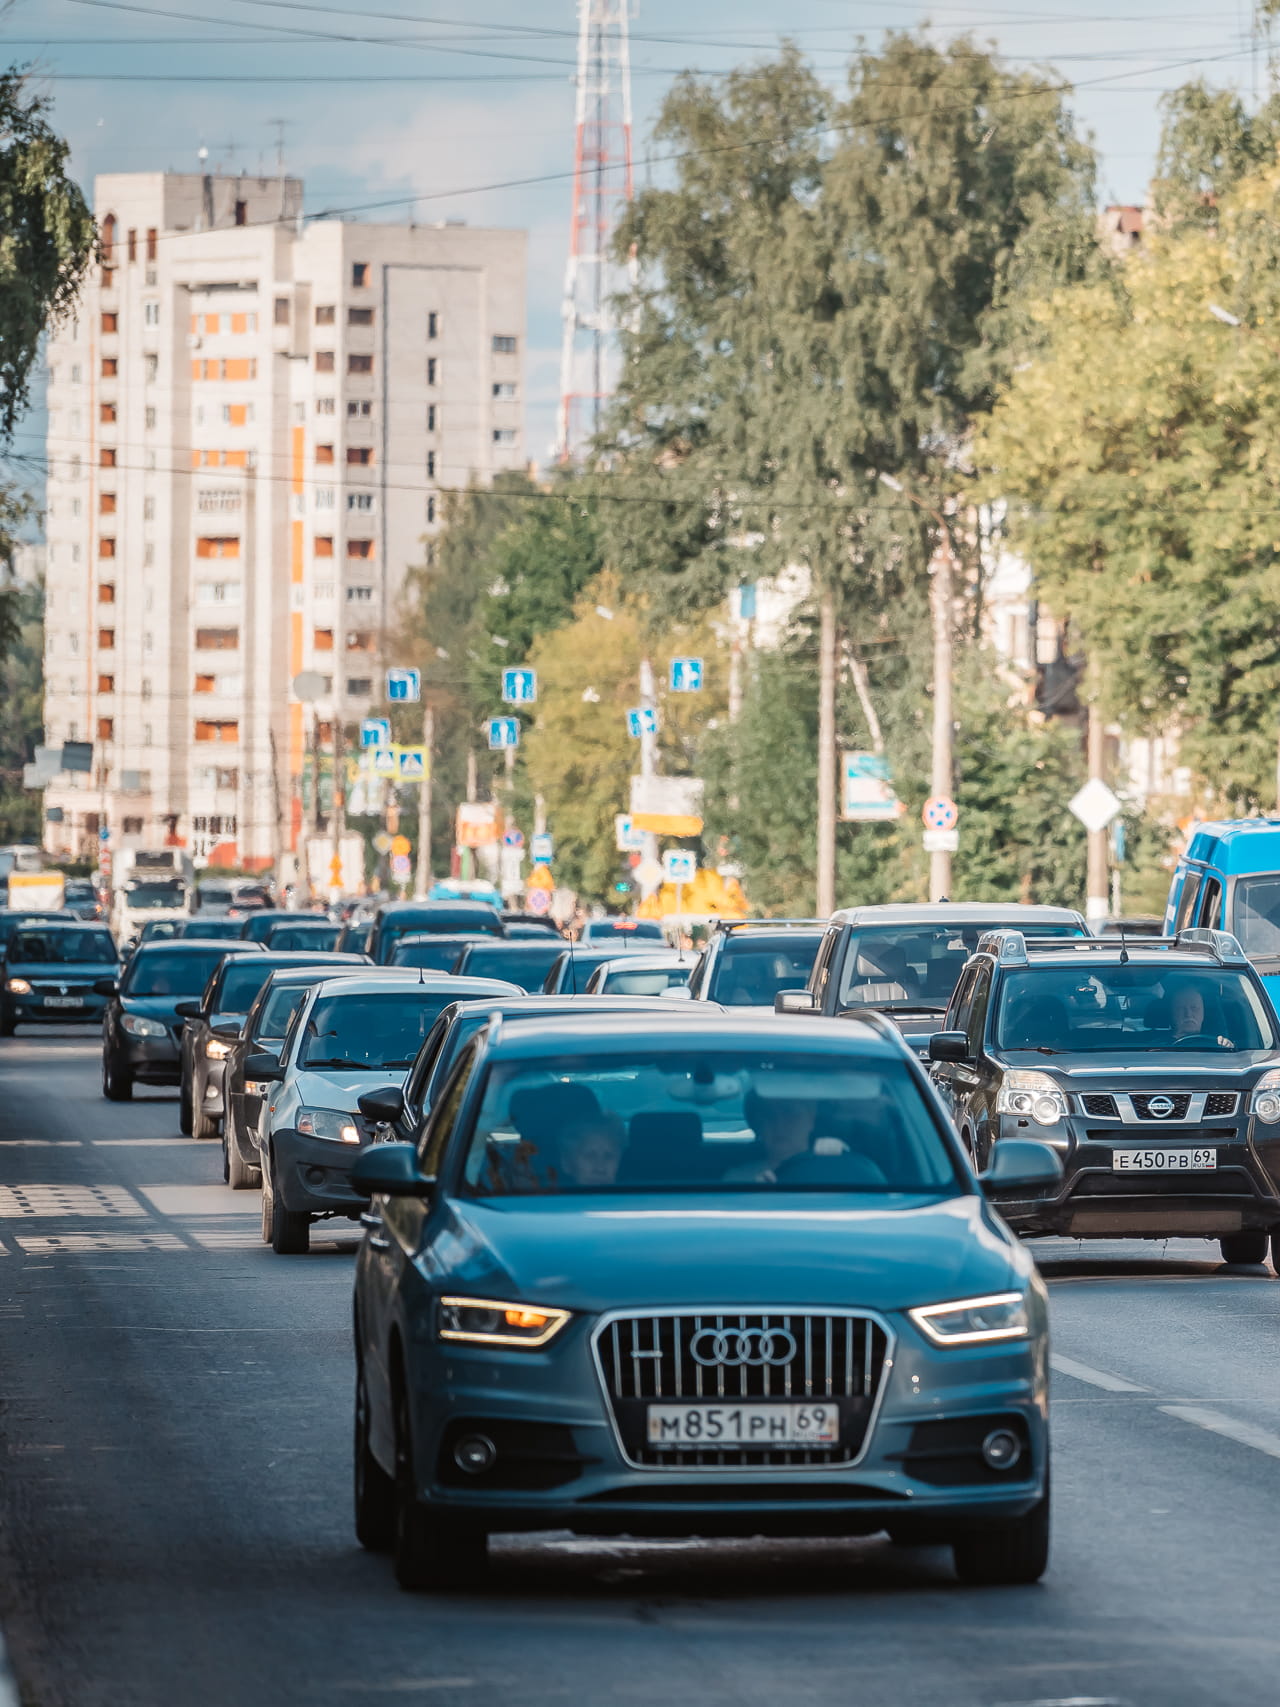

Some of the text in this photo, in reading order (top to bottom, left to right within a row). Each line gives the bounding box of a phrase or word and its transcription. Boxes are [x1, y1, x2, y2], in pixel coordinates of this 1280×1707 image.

[1119, 1150, 1211, 1168] Е450РВ 69
[659, 1407, 828, 1438] М851РН 69
